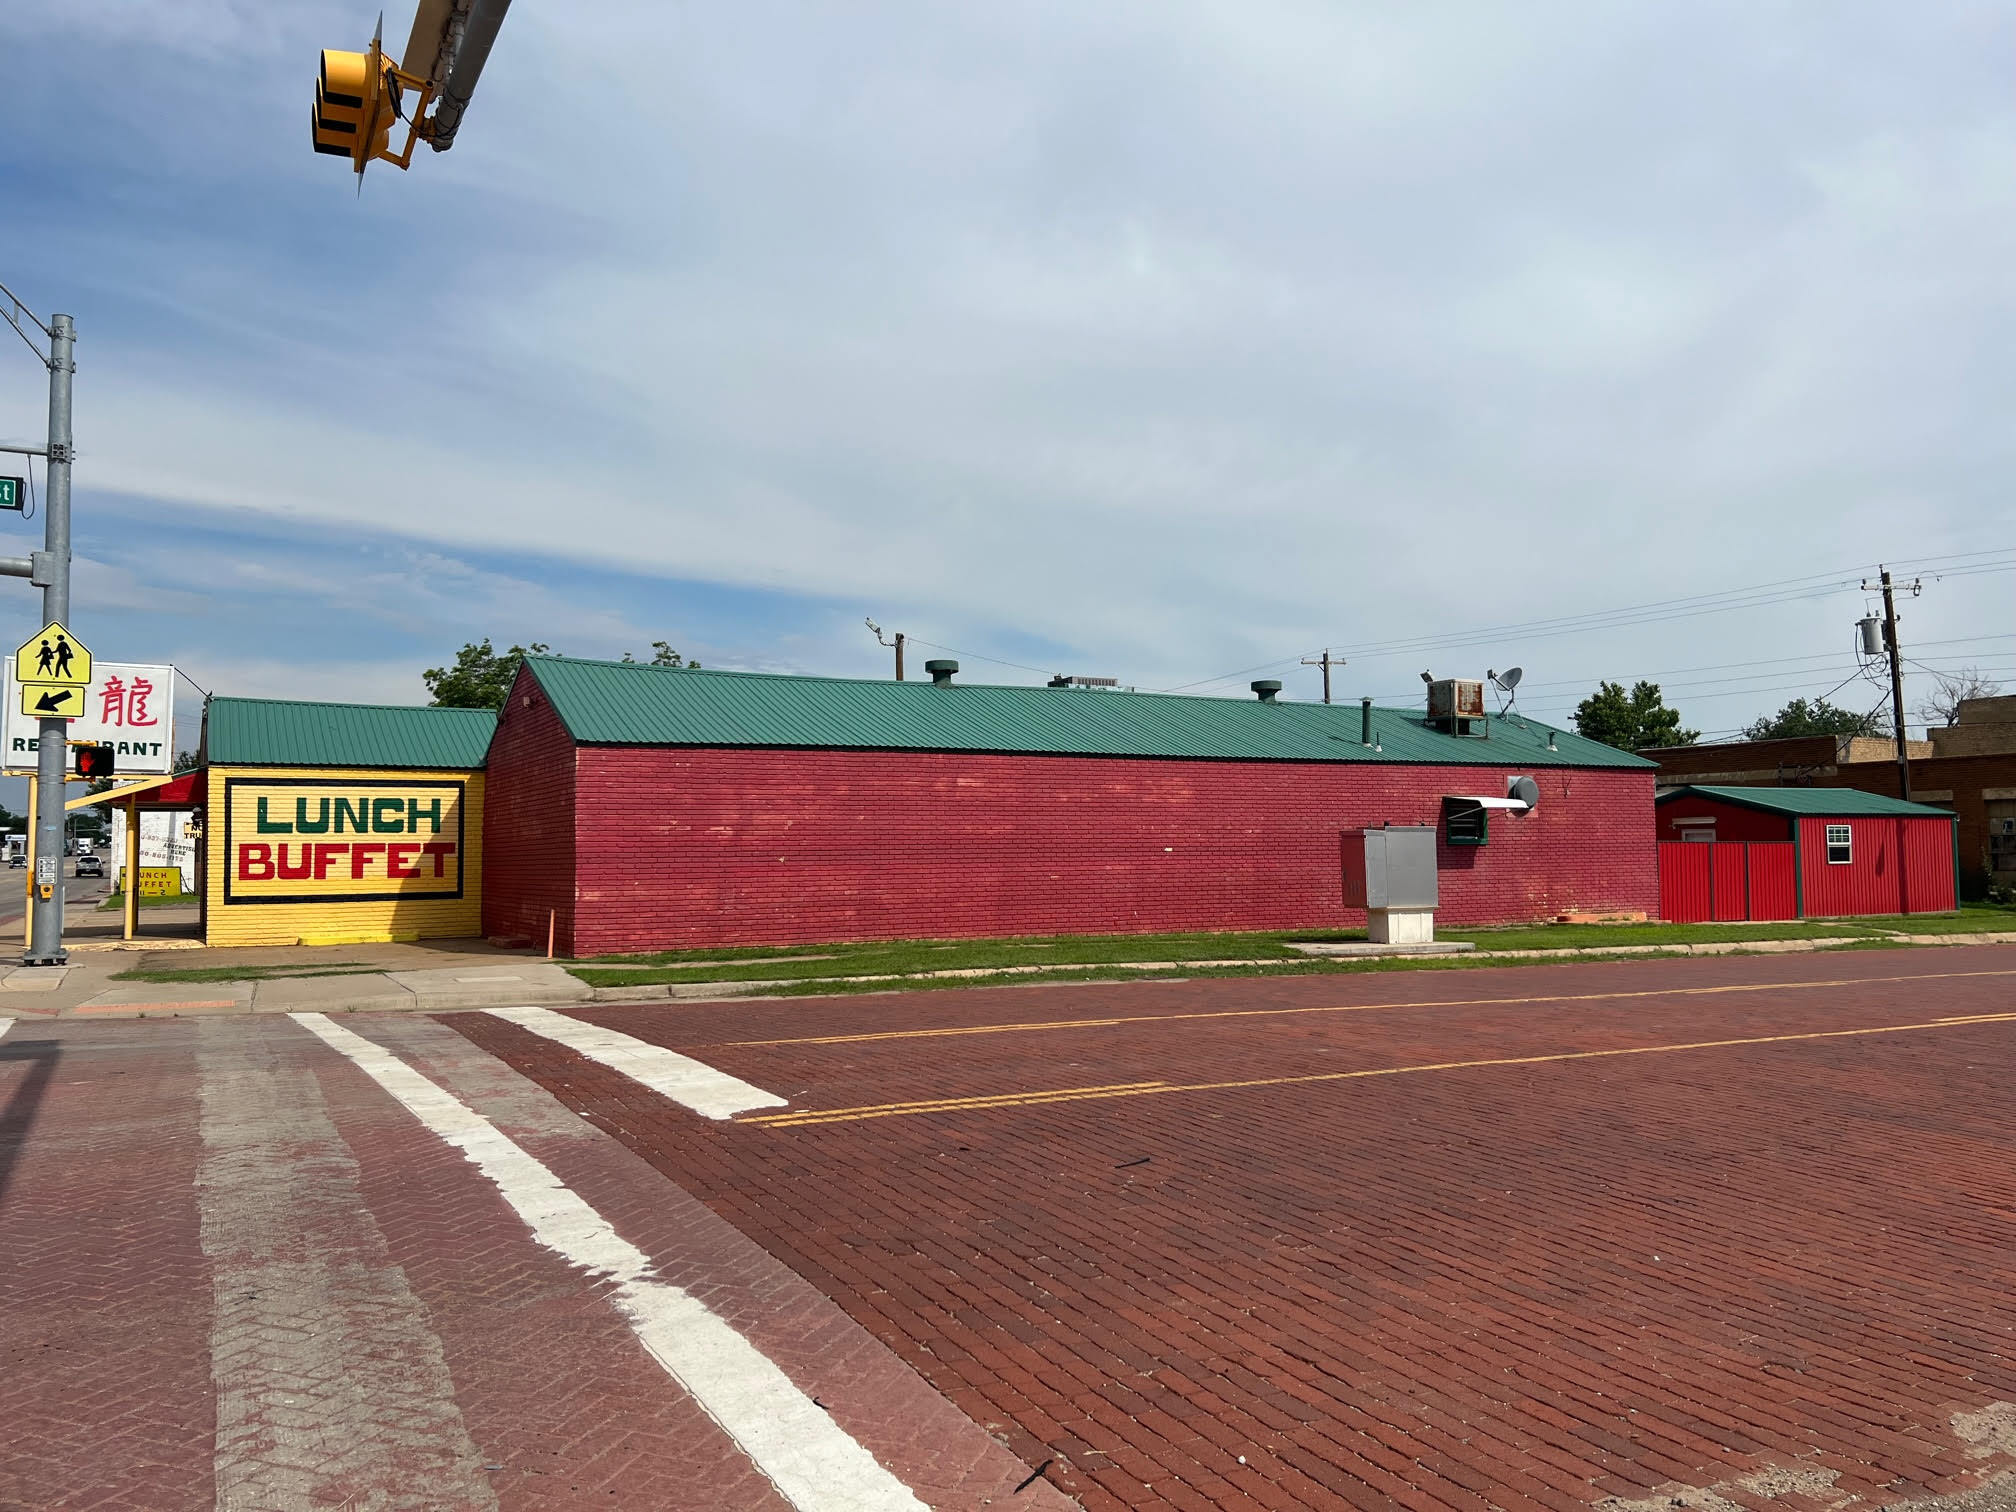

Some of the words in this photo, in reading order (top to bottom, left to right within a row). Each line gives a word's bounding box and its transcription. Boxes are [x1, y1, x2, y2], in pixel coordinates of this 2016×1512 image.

[0, 484, 10, 501] t
[13, 737, 163, 757] RERANT
[257, 796, 441, 834] LUNCH
[238, 843, 456, 881] BUFFET
